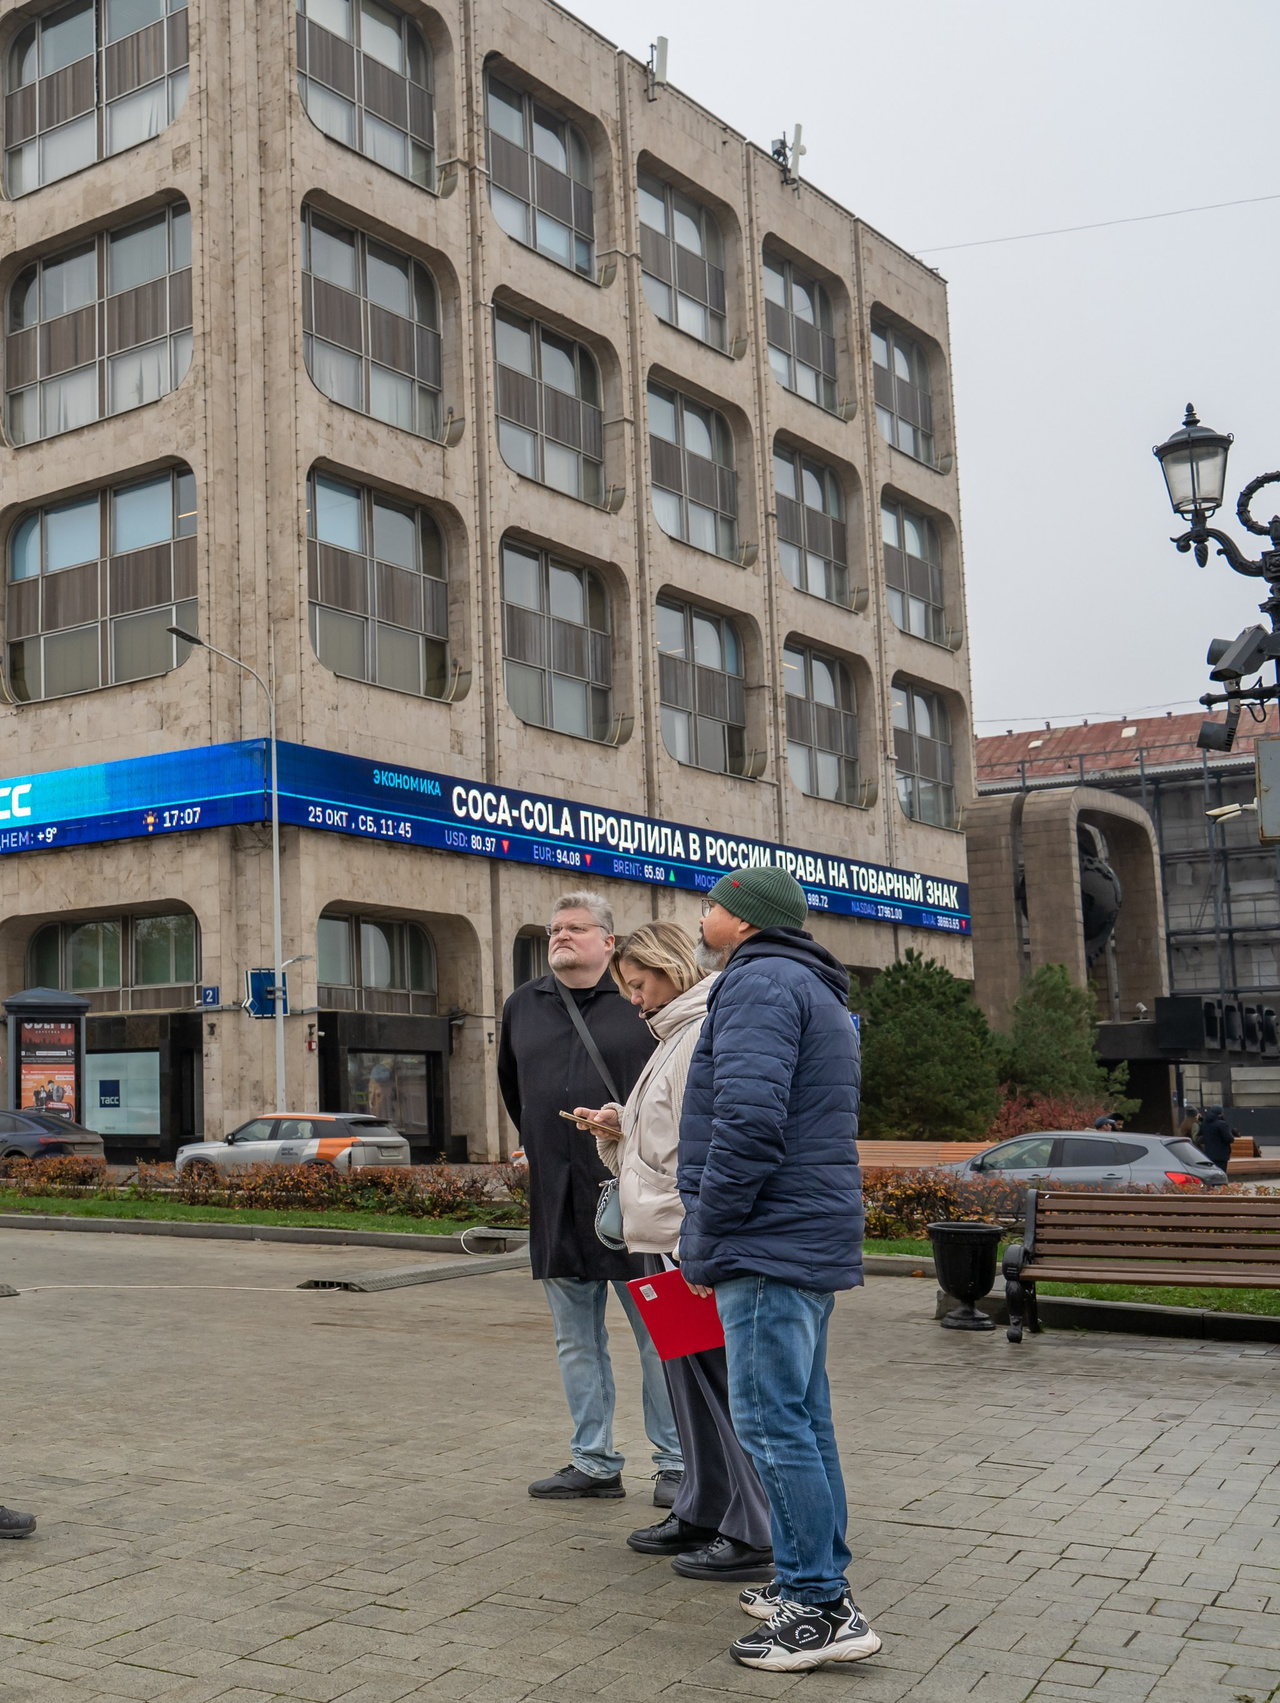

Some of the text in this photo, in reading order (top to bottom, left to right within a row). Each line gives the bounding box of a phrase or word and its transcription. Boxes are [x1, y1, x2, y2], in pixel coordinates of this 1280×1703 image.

[373, 769, 442, 797] ЭКОНОМИКА
[163, 807, 201, 828] 17:07
[308, 806, 323, 823] 25
[325, 809, 348, 827] ОКТ
[358, 815, 378, 834] СБ,
[380, 819, 412, 838] 11:45
[445, 830, 496, 852] USD: 80.97
[452, 785, 959, 909] COCA-COLA ПРОДЛИЛА В РОССИИ ПРАВА НА ТОВАРНЫЙ ЗНАК
[533, 845, 581, 866] EUR: 94.08
[613, 859, 665, 881] BRENT: 65.60
[206, 989, 213, 1002] 2
